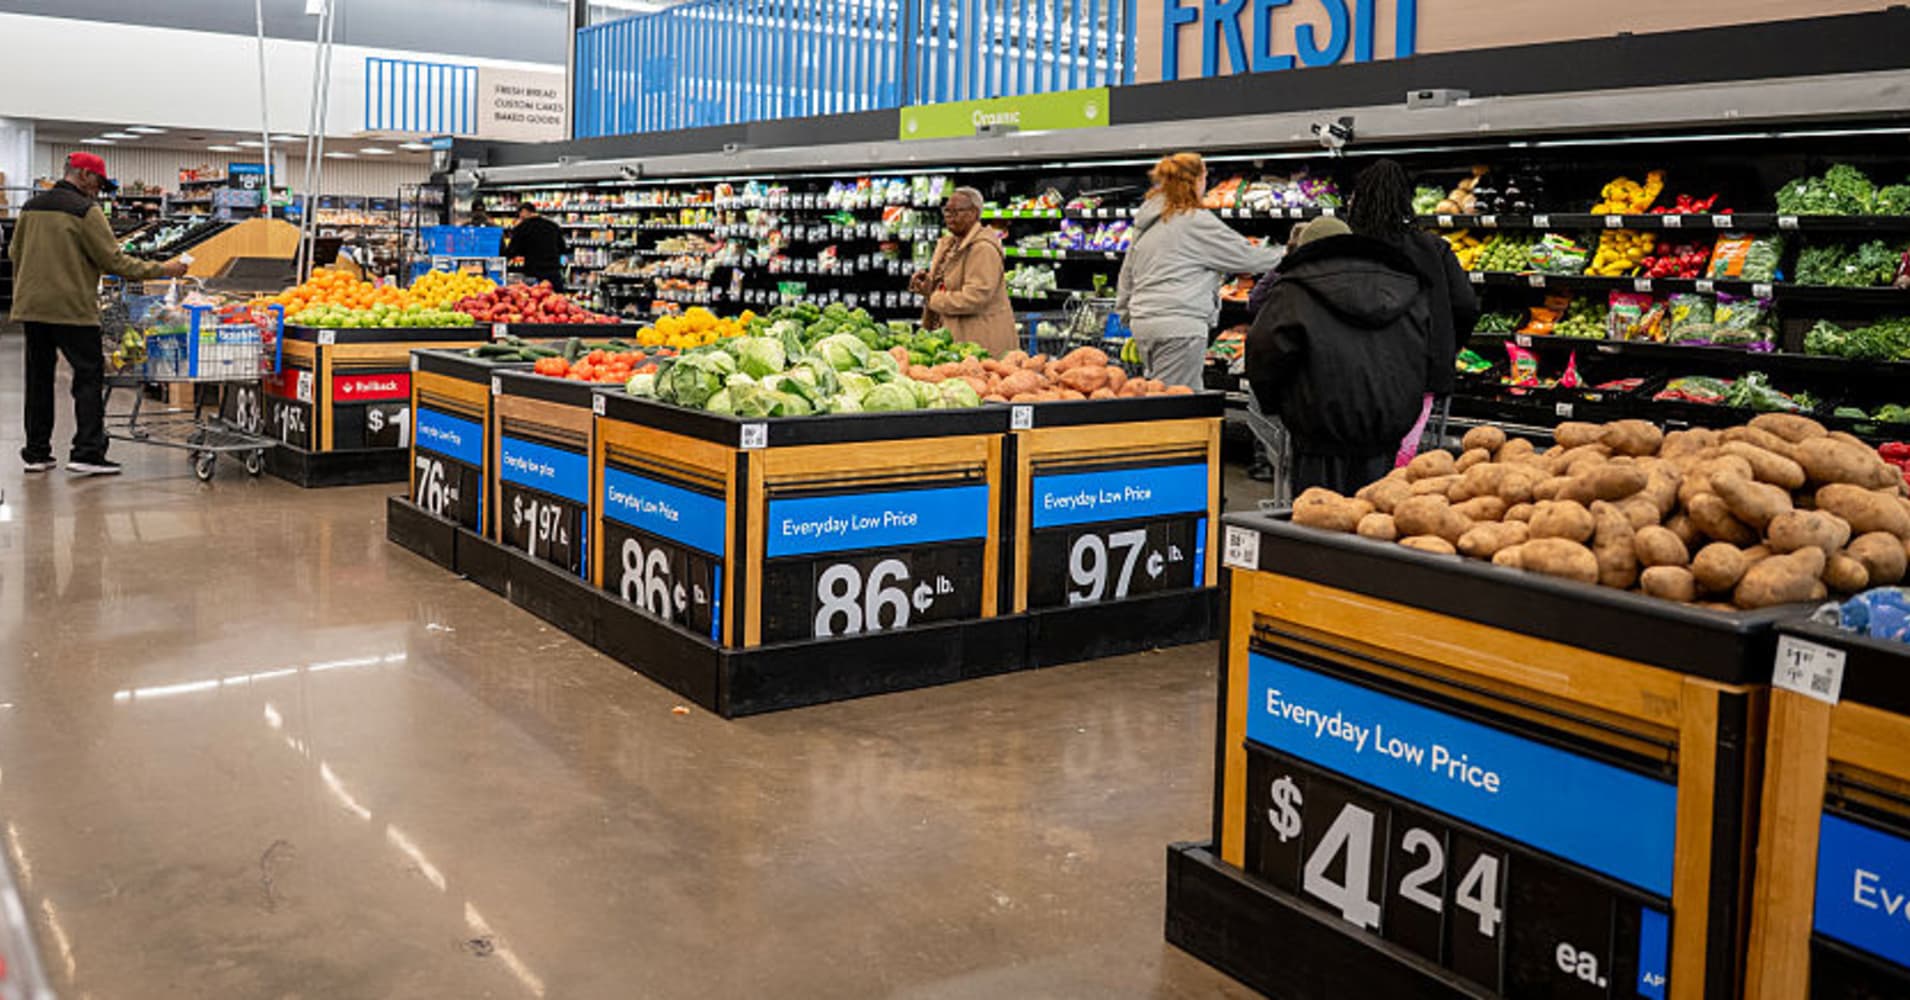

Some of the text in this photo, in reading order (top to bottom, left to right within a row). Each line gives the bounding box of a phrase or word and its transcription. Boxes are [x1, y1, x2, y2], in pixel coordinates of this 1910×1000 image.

[495, 84, 557, 98] FRESH BREAD
[494, 98, 564, 112] CUSTOM CAKES
[972, 109, 1021, 126] Organic
[494, 112, 561, 124] BAKED GOODS
[608, 485, 641, 513] Everyday
[658, 501, 679, 522] Price
[1043, 485, 1152, 510] Everyday Low Price
[782, 510, 918, 539] Everyday Low Price
[1266, 687, 1501, 793] Everyday Low Price
[1555, 942, 1607, 988] ea.
